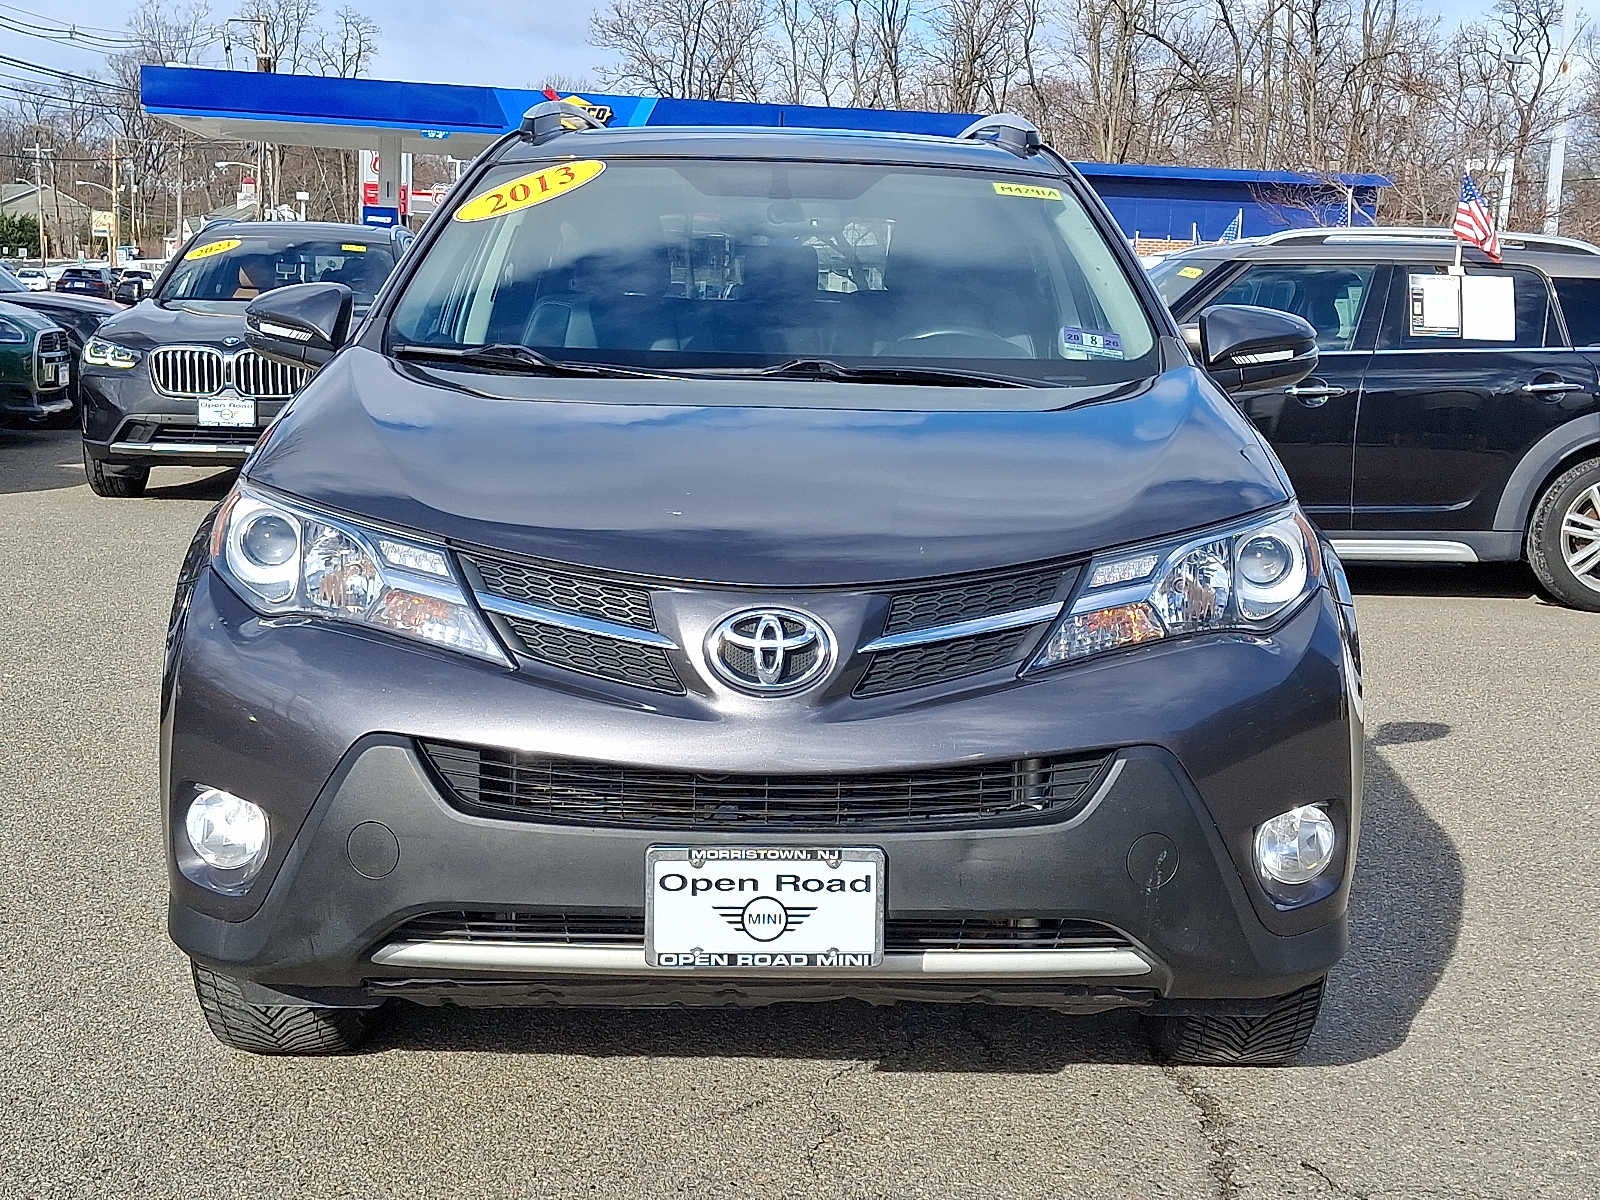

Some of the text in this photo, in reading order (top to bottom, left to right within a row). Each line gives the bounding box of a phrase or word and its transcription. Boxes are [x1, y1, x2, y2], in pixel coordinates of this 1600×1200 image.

[485, 166, 577, 214] 2013
[1090, 335, 1098, 346] 8
[691, 848, 840, 861] MORRISTOWN, NJ
[658, 873, 872, 896] Open Road
[748, 912, 783, 925] MINI
[659, 953, 870, 966] OPEN ROAD MINI
